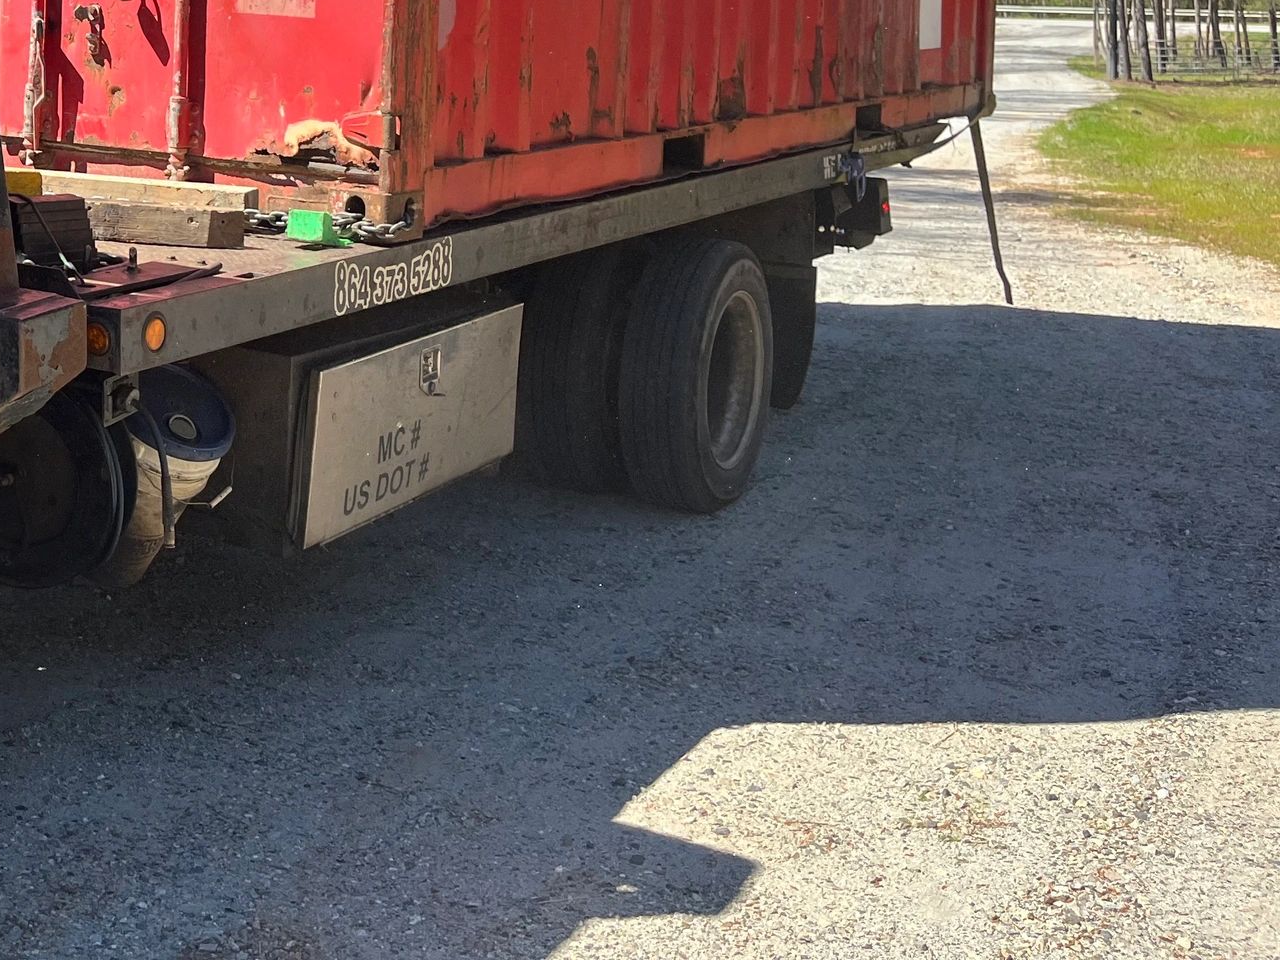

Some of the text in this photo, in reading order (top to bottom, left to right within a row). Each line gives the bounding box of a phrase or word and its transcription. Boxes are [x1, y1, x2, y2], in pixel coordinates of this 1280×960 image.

[334, 235, 453, 316] 864 373 5288
[377, 426, 405, 465] MC
[343, 479, 371, 516] US
[375, 458, 417, 502] DOT
